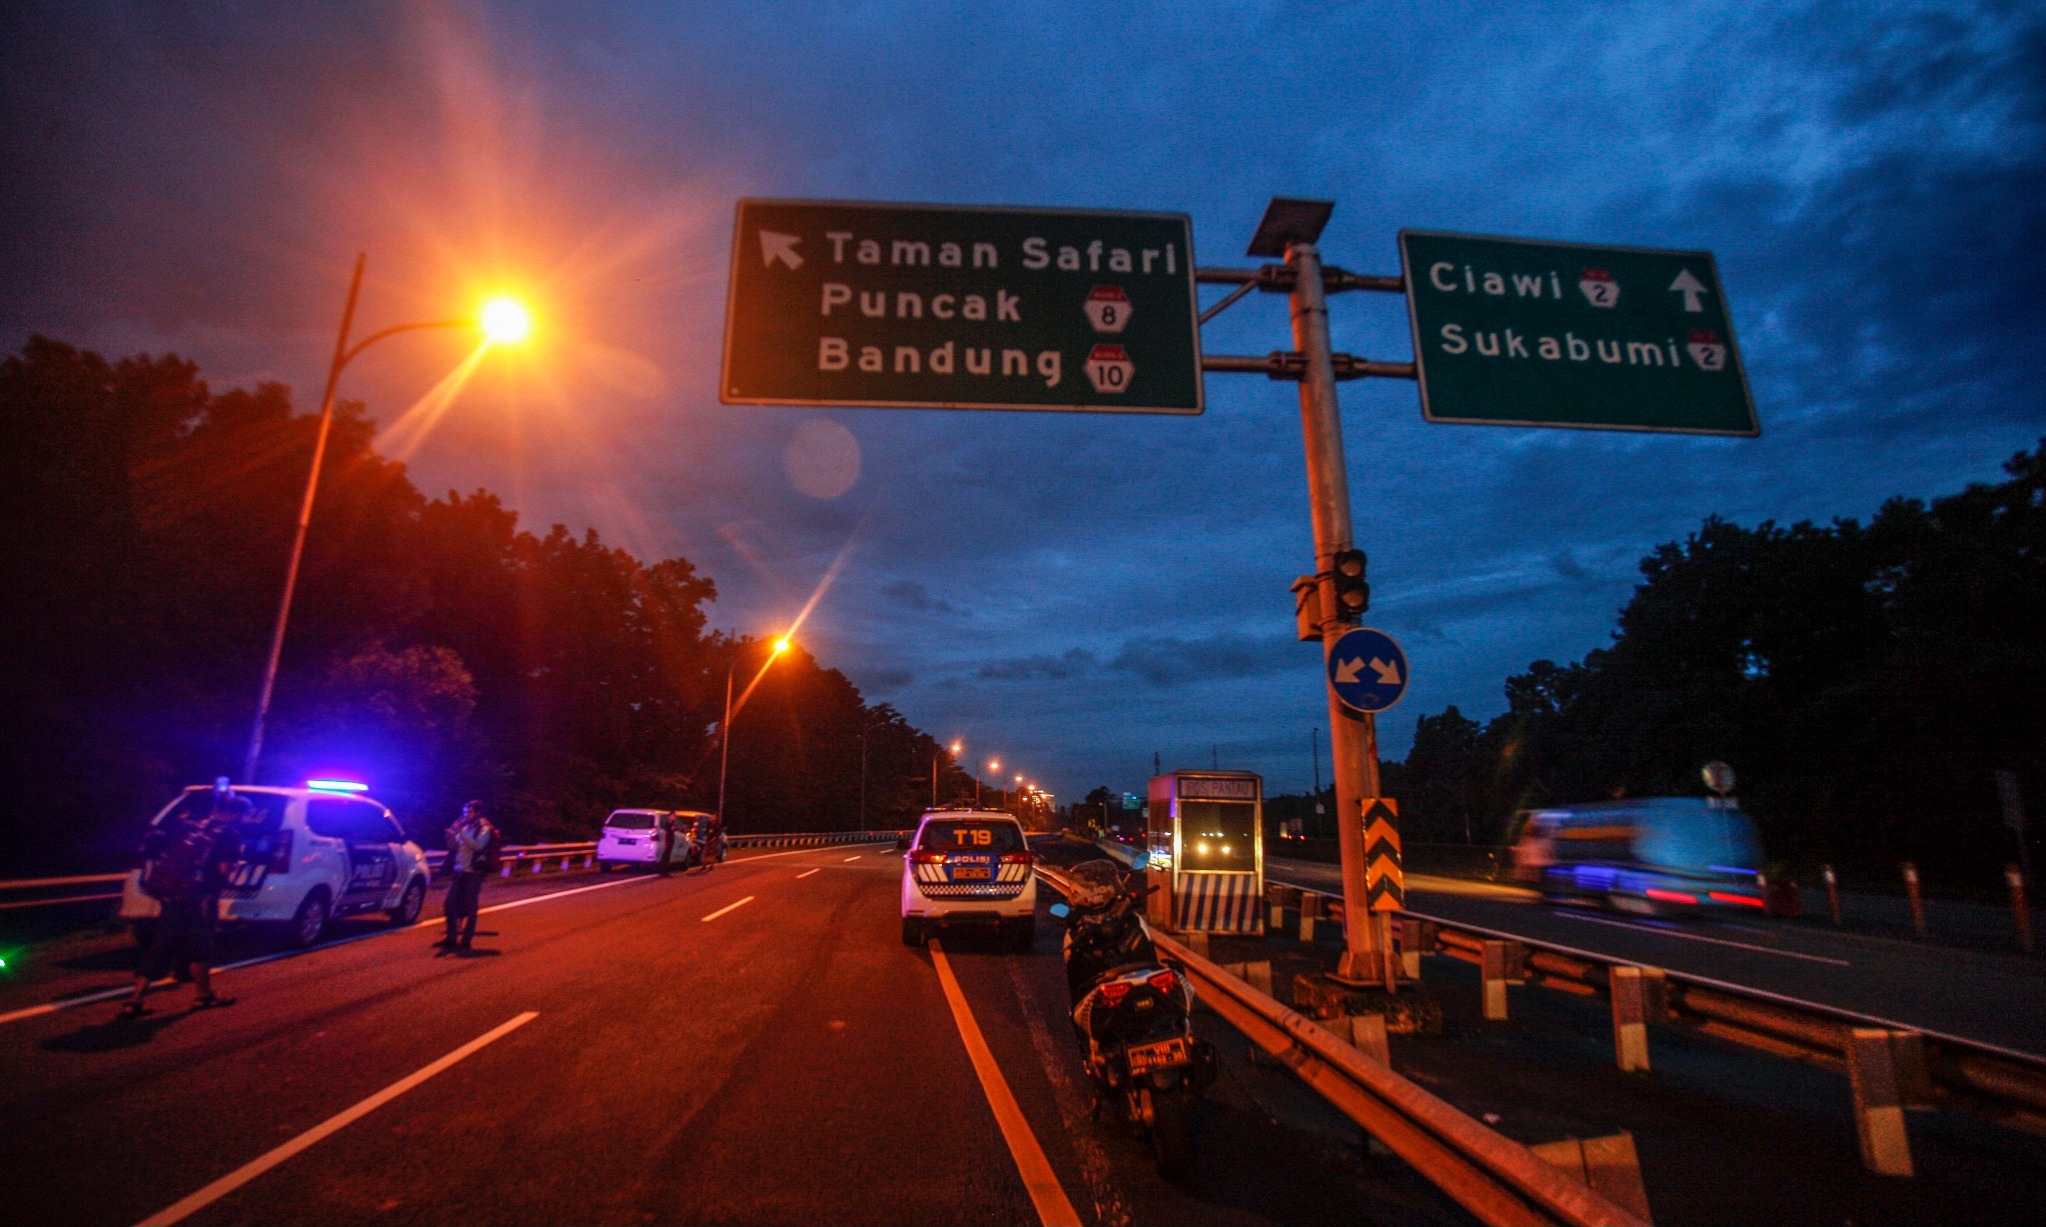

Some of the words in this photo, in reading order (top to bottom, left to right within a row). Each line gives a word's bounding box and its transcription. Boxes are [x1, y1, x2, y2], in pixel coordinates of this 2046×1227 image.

[825, 231, 999, 269] Taman
[1022, 237, 1177, 274] Safari
[1429, 261, 1562, 300] Ciawi
[1593, 284, 1608, 303] 2
[819, 282, 1022, 322] Puncak
[1102, 306, 1116, 325] 8
[1440, 323, 1681, 367] Sukabumi
[1700, 346, 1716, 365] 2
[817, 337, 1062, 388] Bandung
[1097, 365, 1123, 386] 10
[953, 855, 990, 864] POLISI
